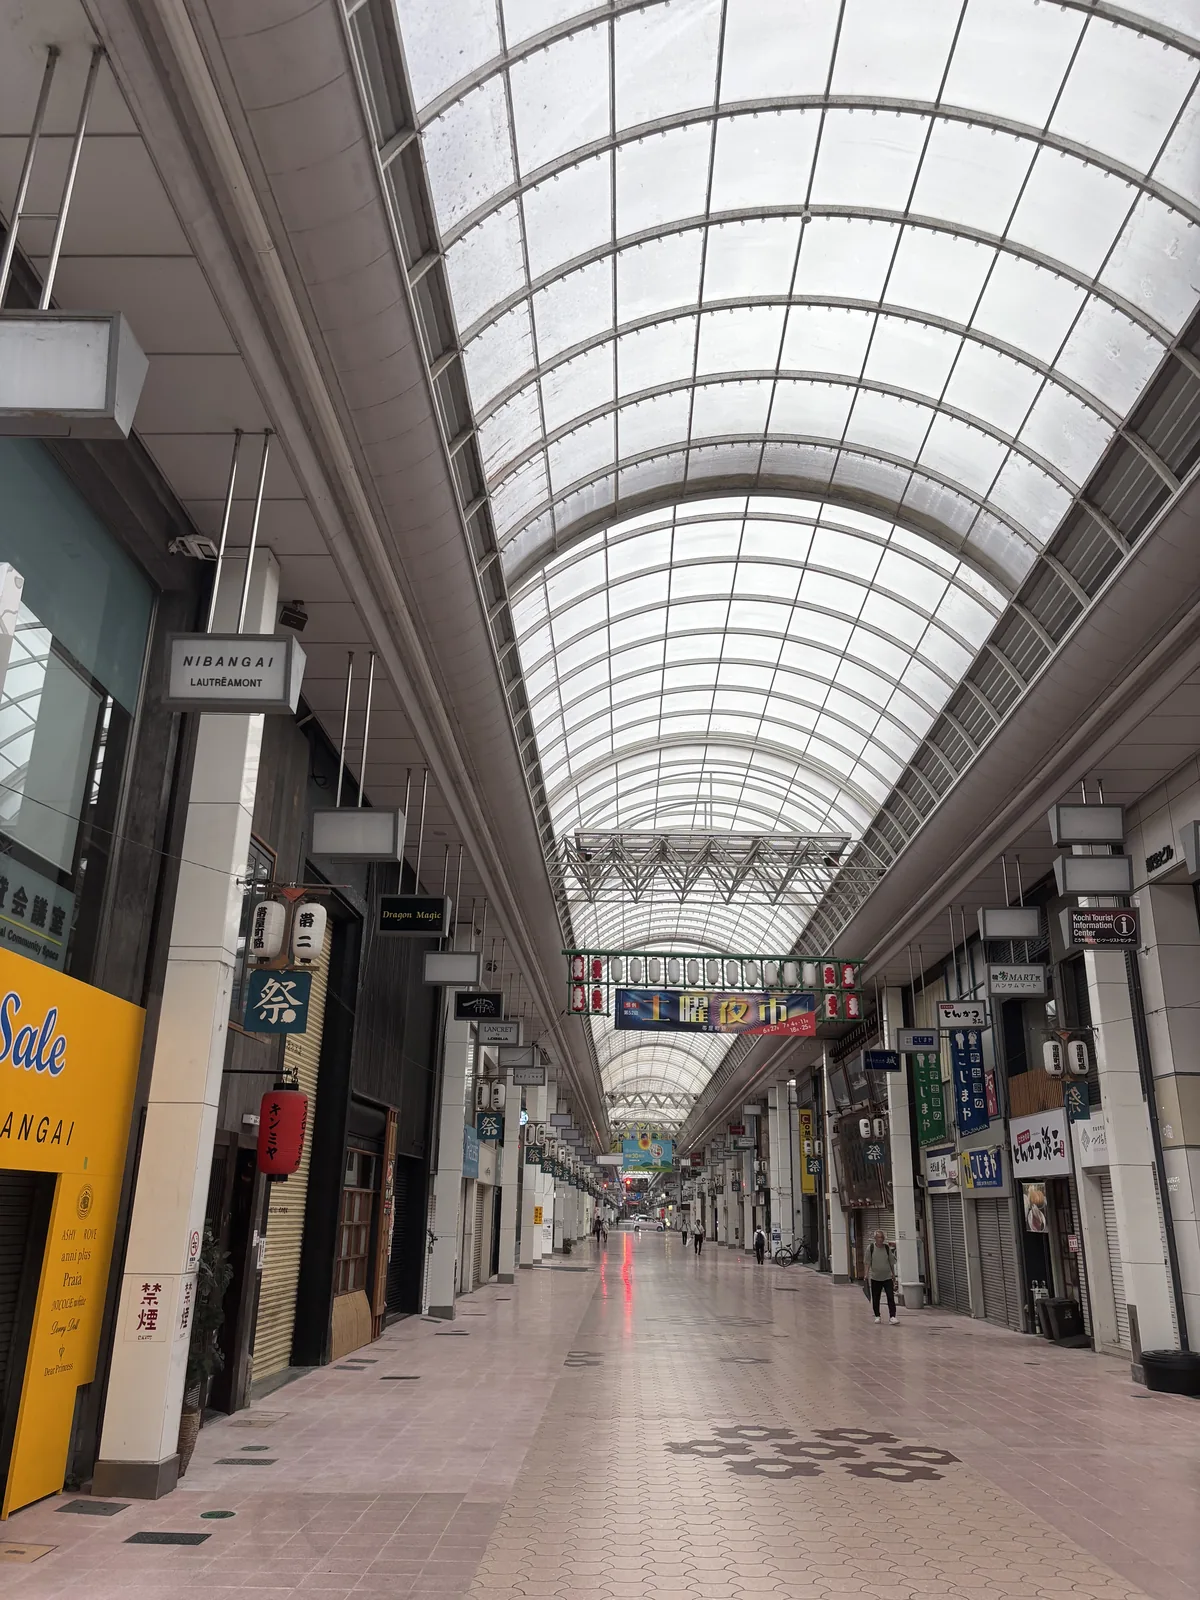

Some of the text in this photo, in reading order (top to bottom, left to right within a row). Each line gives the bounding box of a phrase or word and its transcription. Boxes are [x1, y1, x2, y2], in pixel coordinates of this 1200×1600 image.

[183, 656, 273, 667] NIBANGAI
[383, 911, 441, 921] Dragon Magic
[253, 977, 304, 1024] 祭
[642, 994, 788, 1025] 土曜夜市
[944, 1010, 979, 1018] とんかつ
[0, 990, 67, 1078] Sale
[958, 1053, 973, 1121] こじまや
[919, 1071, 931, 1131] こじまや
[0, 1111, 75, 1146] ANGAI
[266, 1103, 281, 1160] キンミヤ
[480, 1116, 500, 1136] 祭
[961, 1124, 989, 1137] KOJIMAYA
[971, 1154, 997, 1179] こじまや
[61, 1249, 77, 1262] anni
[63, 1272, 82, 1287] Praia
[136, 1283, 162, 1331] 禁煙
[44, 1367, 55, 1377] Dear
